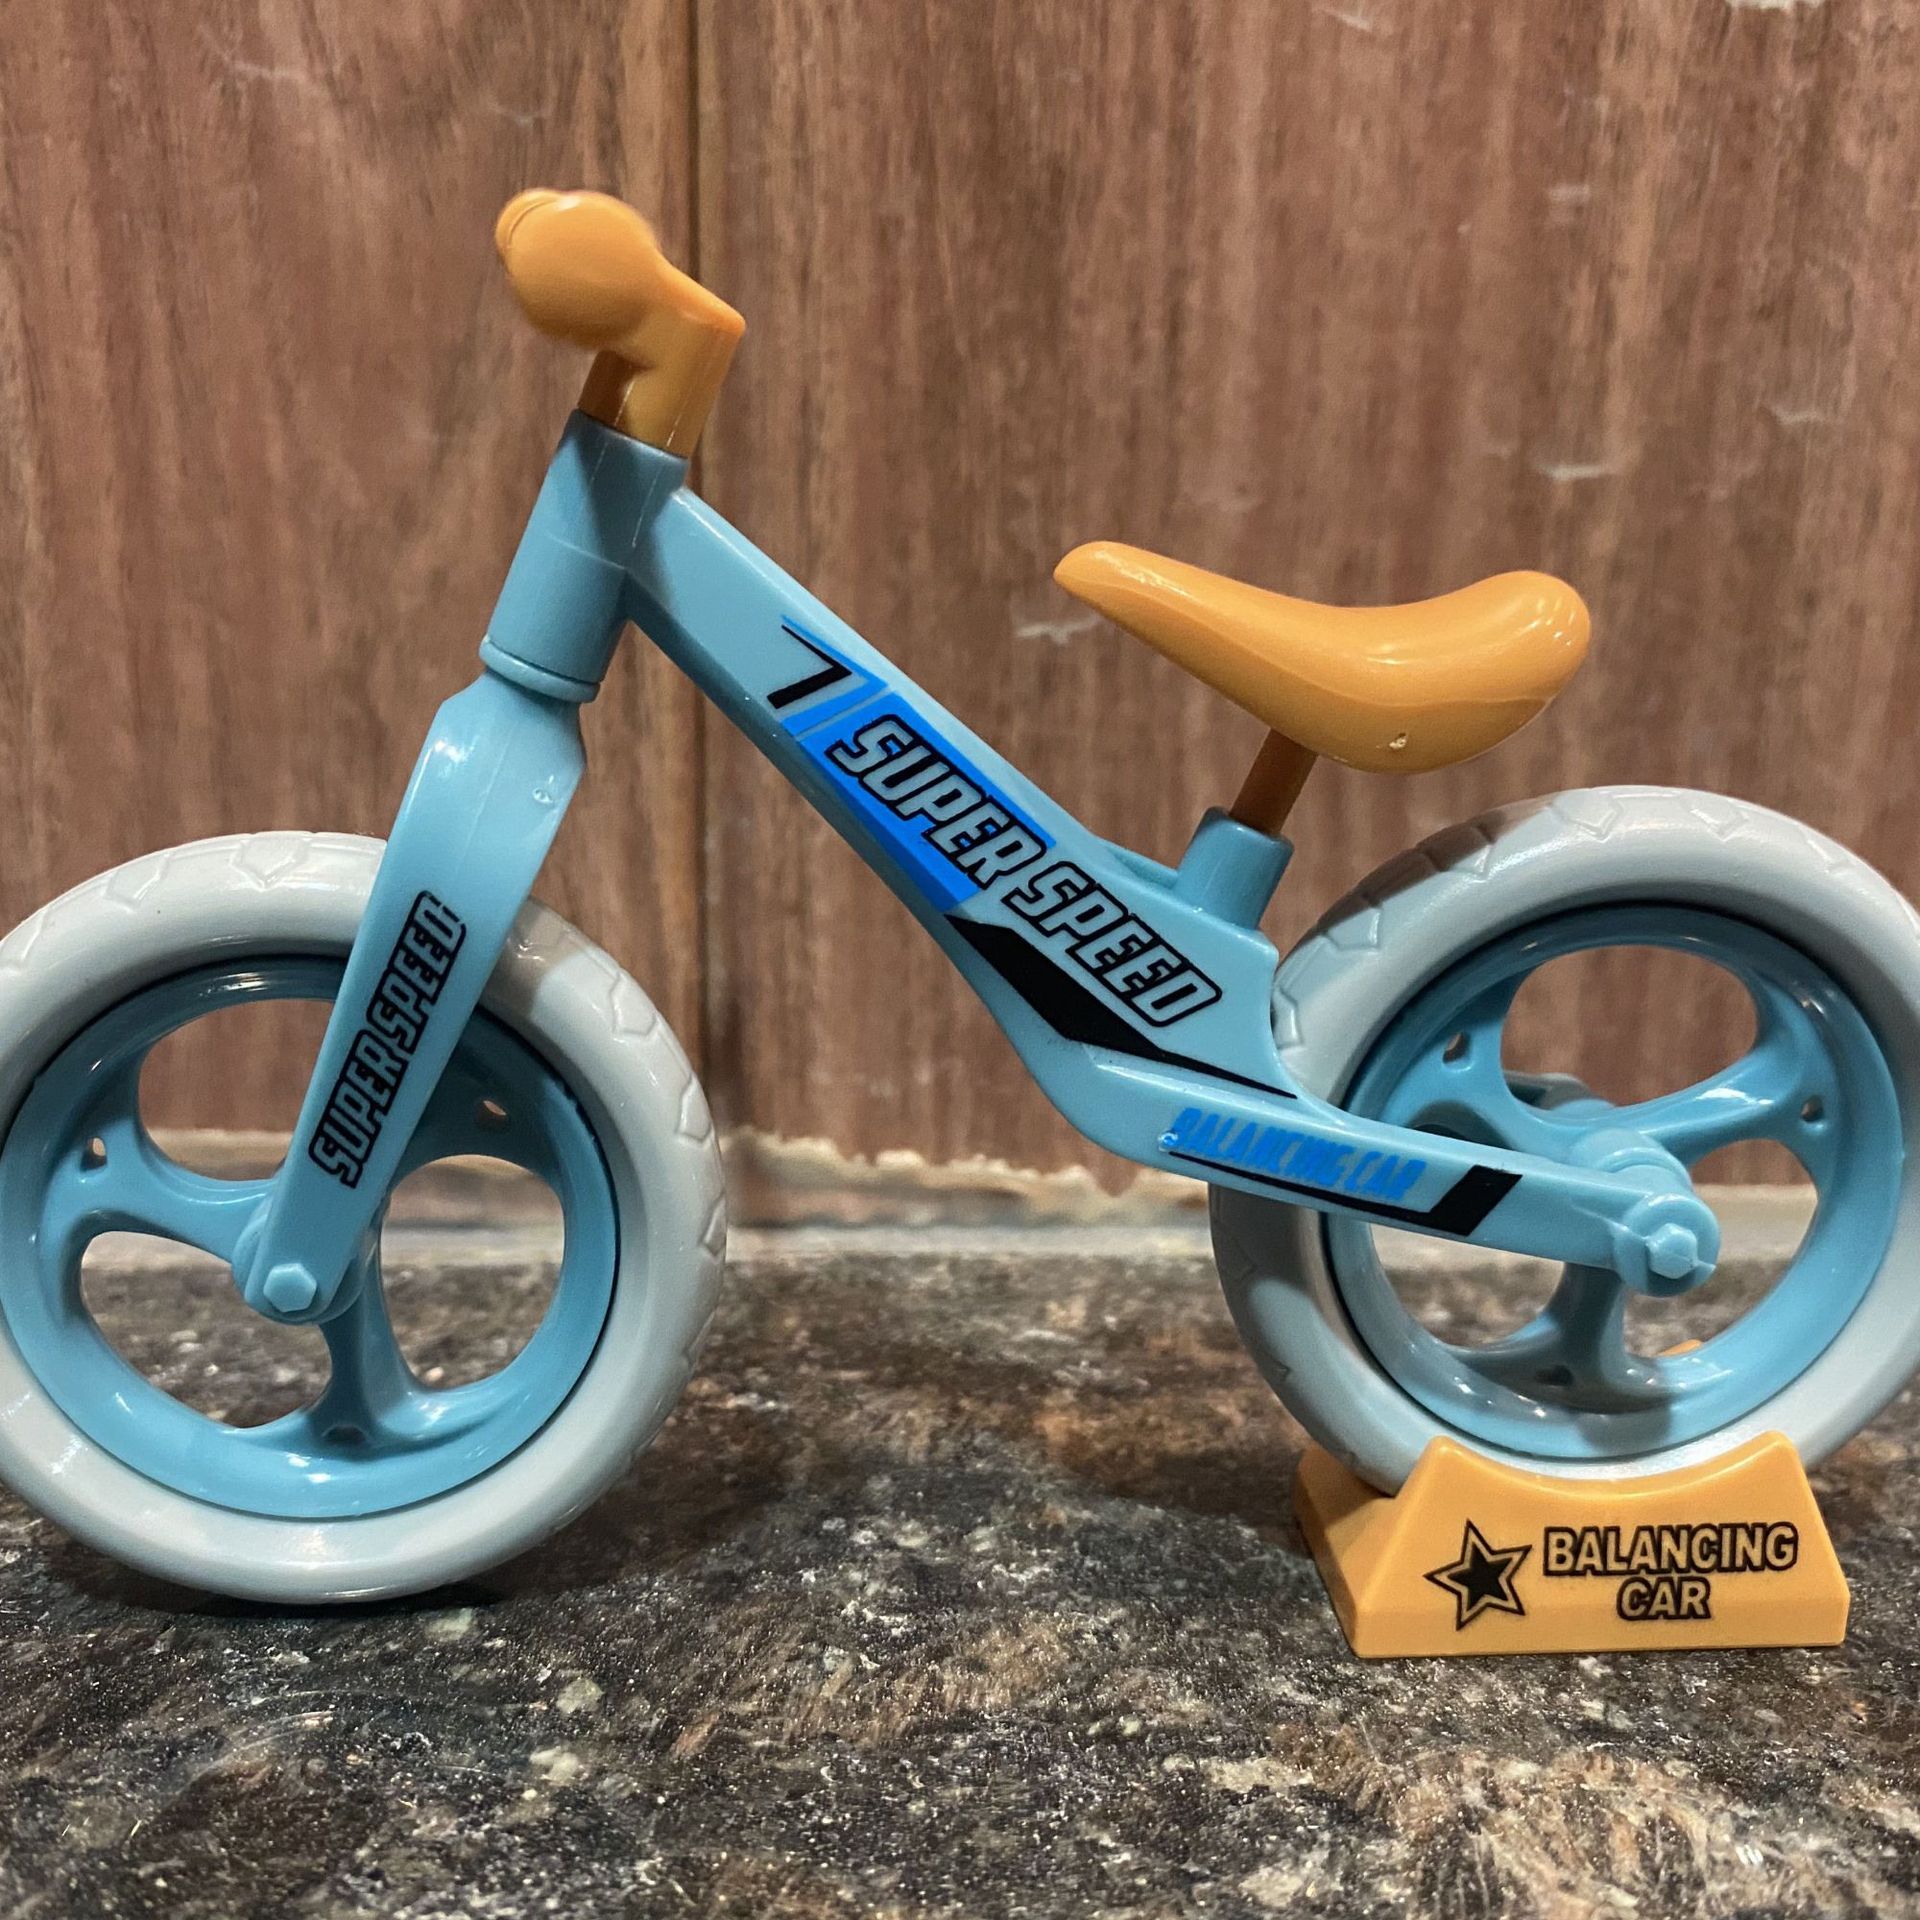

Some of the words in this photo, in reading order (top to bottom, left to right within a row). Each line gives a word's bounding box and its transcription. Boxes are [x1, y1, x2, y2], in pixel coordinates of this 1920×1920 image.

[824, 714, 1047, 889] SUPER
[1001, 861, 1222, 1027] SPEED
[308, 1029, 408, 1188] SUPER
[366, 890, 466, 1055] SPEED
[1543, 1522, 1799, 1576] BALANCING
[1616, 1576, 1712, 1621] CAR
